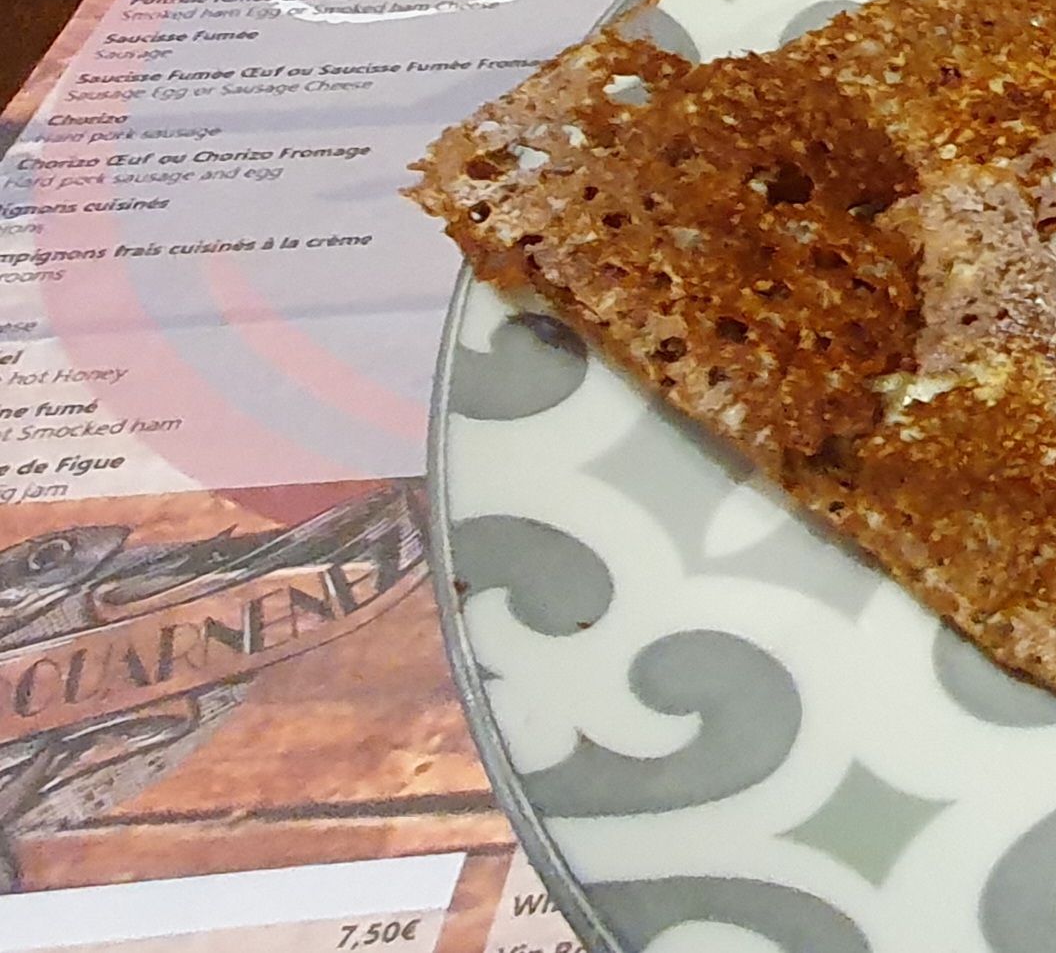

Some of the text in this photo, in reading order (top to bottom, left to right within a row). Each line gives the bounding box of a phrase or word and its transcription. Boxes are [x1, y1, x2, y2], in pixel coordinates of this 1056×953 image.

[103, 29, 259, 45] Saucisse Fumée
[76, 70, 162, 85] Saucisse
[167, 68, 236, 81] Fumée
[287, 67, 313, 78] ou
[318, 62, 402, 76] Saucisse
[406, 60, 472, 73] Fumée
[221, 81, 300, 96] Sausage
[303, 78, 374, 93] Cheese
[17, 145, 372, 171] Chorizo Œuf ou Chorizo Fromage
[112, 169, 196, 186] sausage
[200, 166, 242, 181] and
[243, 166, 285, 182] egg
[0, 196, 171, 220] ignons cuisinés
[114, 242, 164, 258] frais
[168, 238, 257, 256] cuisinés
[260, 236, 276, 251] à
[279, 235, 300, 250] la
[306, 232, 374, 249] crème
[8, 367, 130, 386] hot Honey
[35, 397, 100, 419] fumé
[16, 418, 129, 442] Smocked
[130, 417, 183, 434] ham
[16, 458, 49, 476] de
[55, 454, 126, 477] Figue
[21, 482, 69, 500] jam
[337, 918, 422, 952] 7,50€
